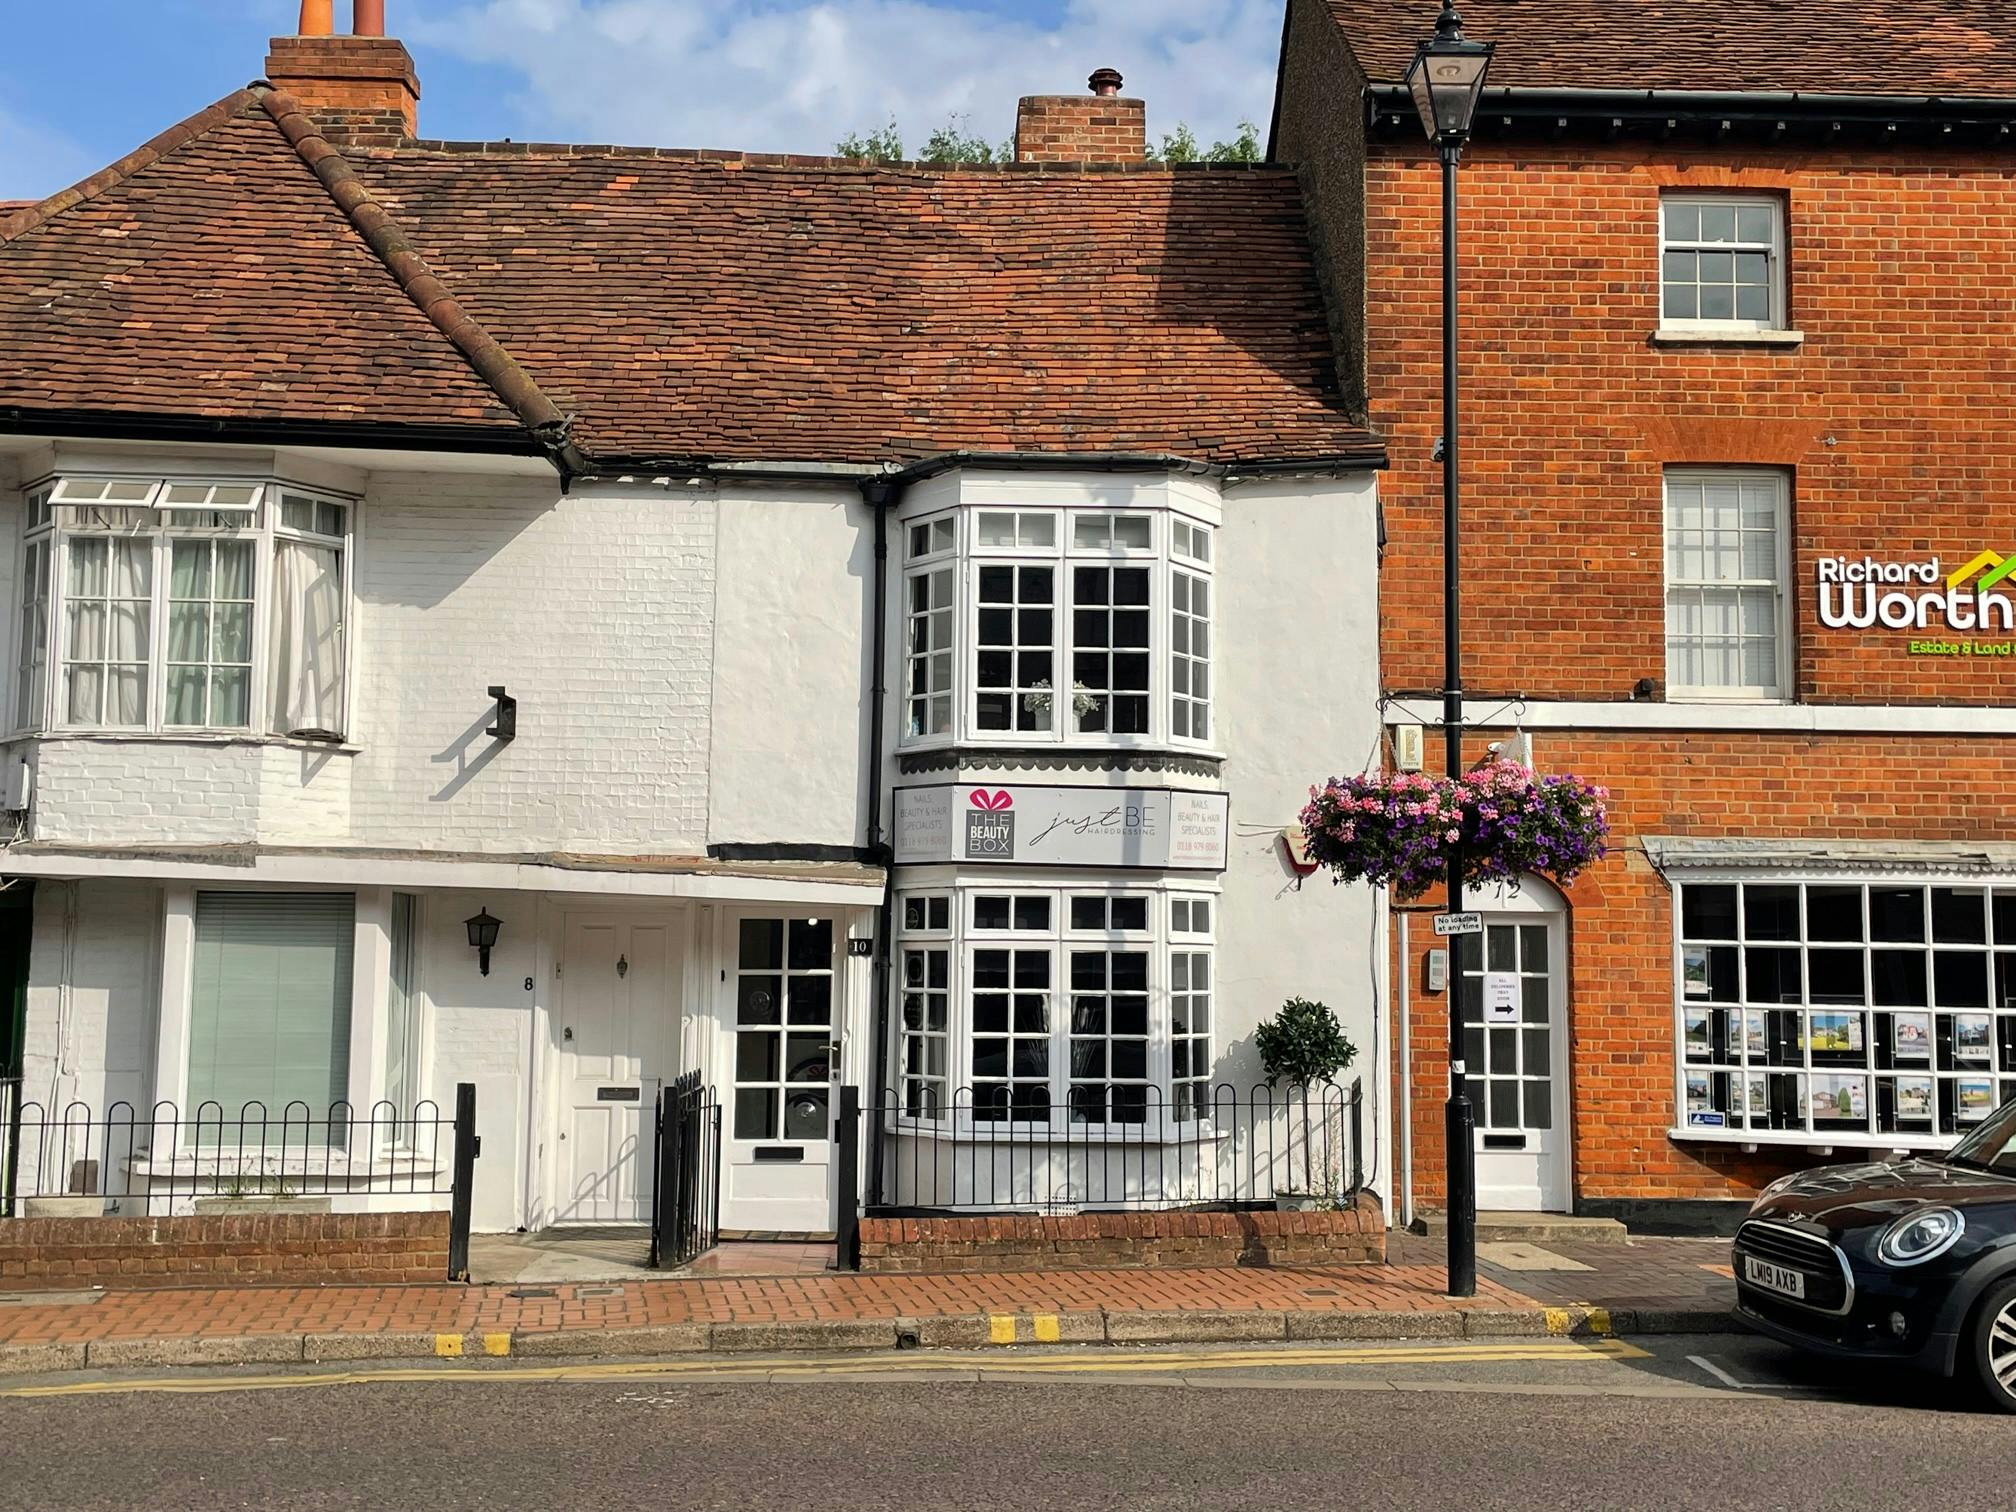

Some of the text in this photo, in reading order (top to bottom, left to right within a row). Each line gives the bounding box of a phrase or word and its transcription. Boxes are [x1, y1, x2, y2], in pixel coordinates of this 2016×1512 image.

[1819, 556, 1939, 583] Richard
[1911, 641, 2011, 655] Estate & Land
[1191, 800, 1209, 810] NAILS
[901, 808, 924, 818] BEAUTY
[932, 807, 946, 816] HAIR
[1178, 812, 1200, 822] BEAUTY
[1207, 814, 1221, 823] HAIR
[904, 819, 943, 830] SPECIALISTS
[972, 813, 1010, 826] THE
[971, 826, 1009, 840] BEAUTY
[1181, 825, 1217, 836] SPECIALISTS
[970, 839, 1009, 852] BOX
[1494, 880, 1521, 899] 12
[1451, 915, 1478, 923] loading
[854, 941, 867, 953] 10
[524, 977, 533, 991] 8
[1776, 1268, 1797, 1292] AXB
